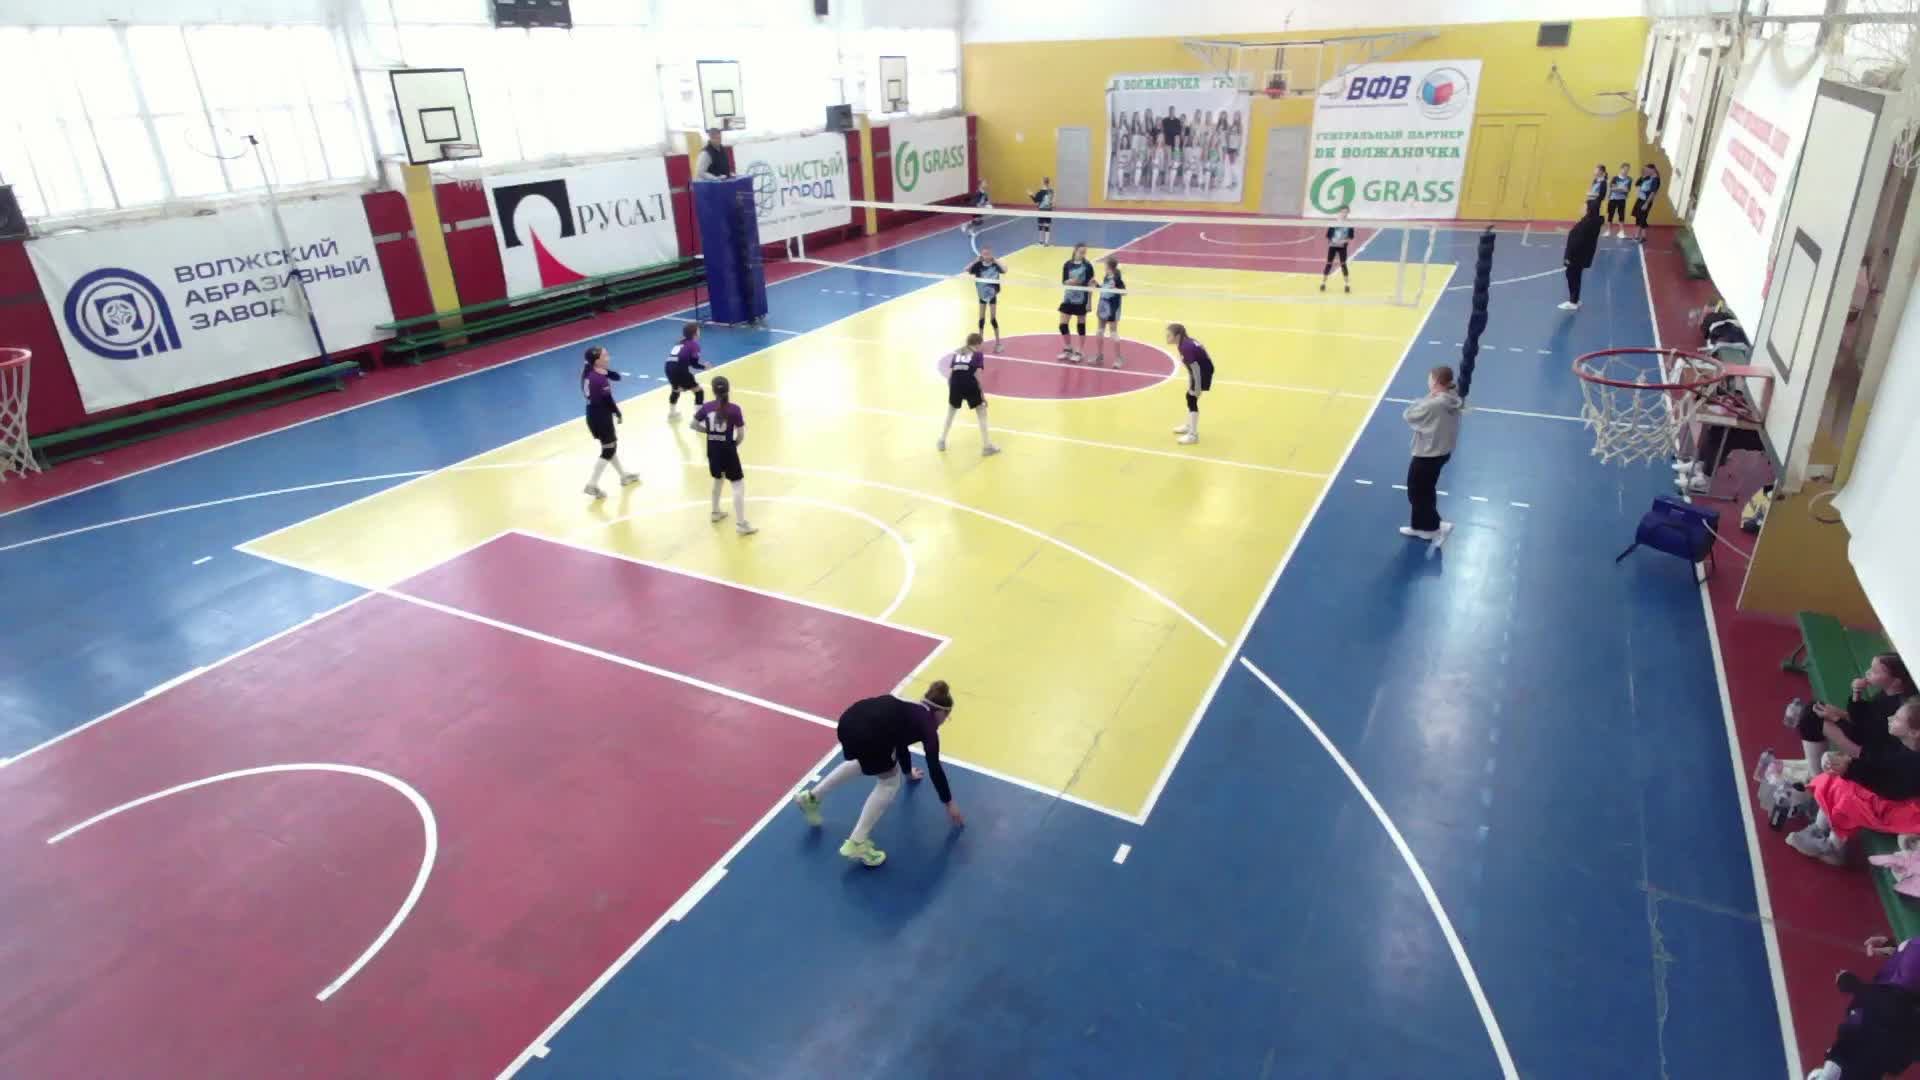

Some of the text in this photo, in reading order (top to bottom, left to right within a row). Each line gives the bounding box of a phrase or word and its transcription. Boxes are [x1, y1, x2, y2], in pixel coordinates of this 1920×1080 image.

[1346, 75, 1411, 101] ВФВ
[1407, 129, 1465, 140] ПАРТНЕР
[922, 144, 965, 175] GRASS
[1341, 146, 1461, 159] ВОЛЖАНОЧКА
[777, 151, 844, 186] ЧИСТЫЙ
[1362, 179, 1456, 203] GRASS
[576, 193, 668, 235] РУСАЛ
[174, 237, 340, 284] ВОЛЖСКИЙ
[184, 256, 372, 308] АБРАЗИВНЫЙ
